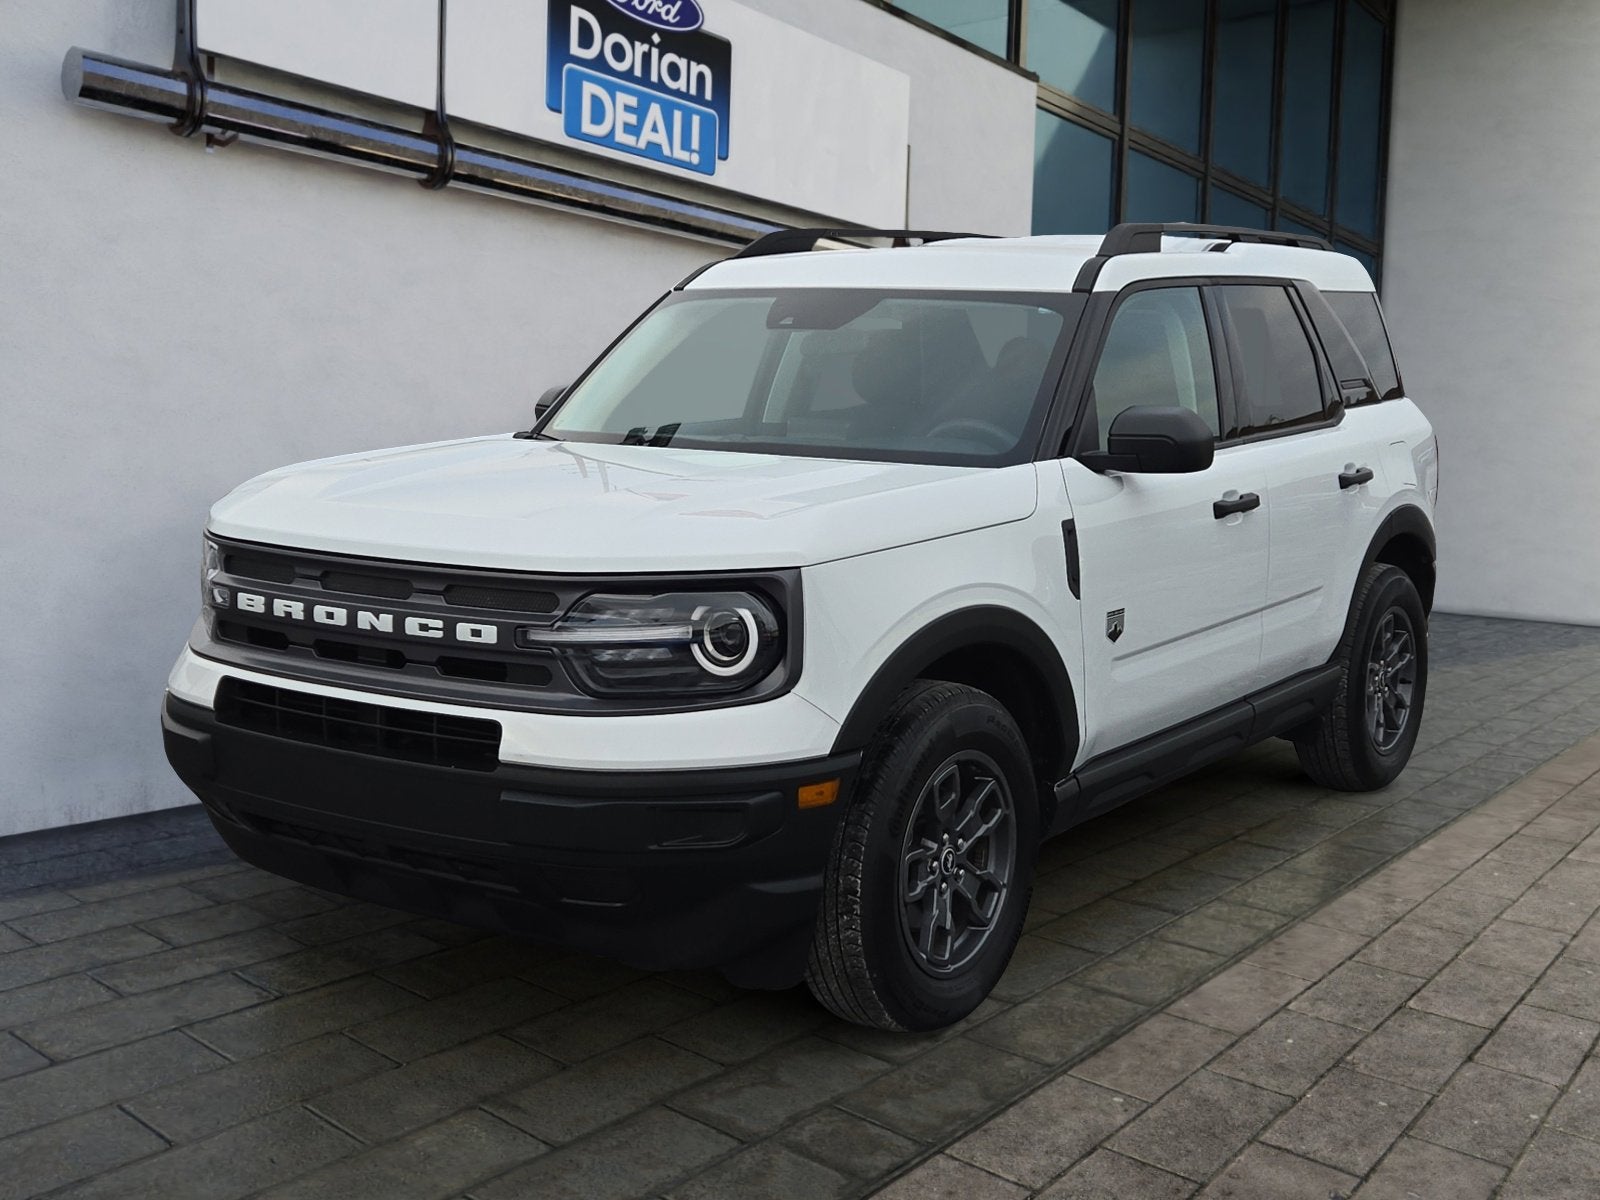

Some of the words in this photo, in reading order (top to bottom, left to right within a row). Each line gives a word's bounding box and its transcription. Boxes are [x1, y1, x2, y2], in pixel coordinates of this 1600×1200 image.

[618, 0, 681, 24] ord
[569, 4, 713, 101] Dorian
[580, 80, 701, 165] DEAL!
[236, 592, 498, 644] BRONCO
